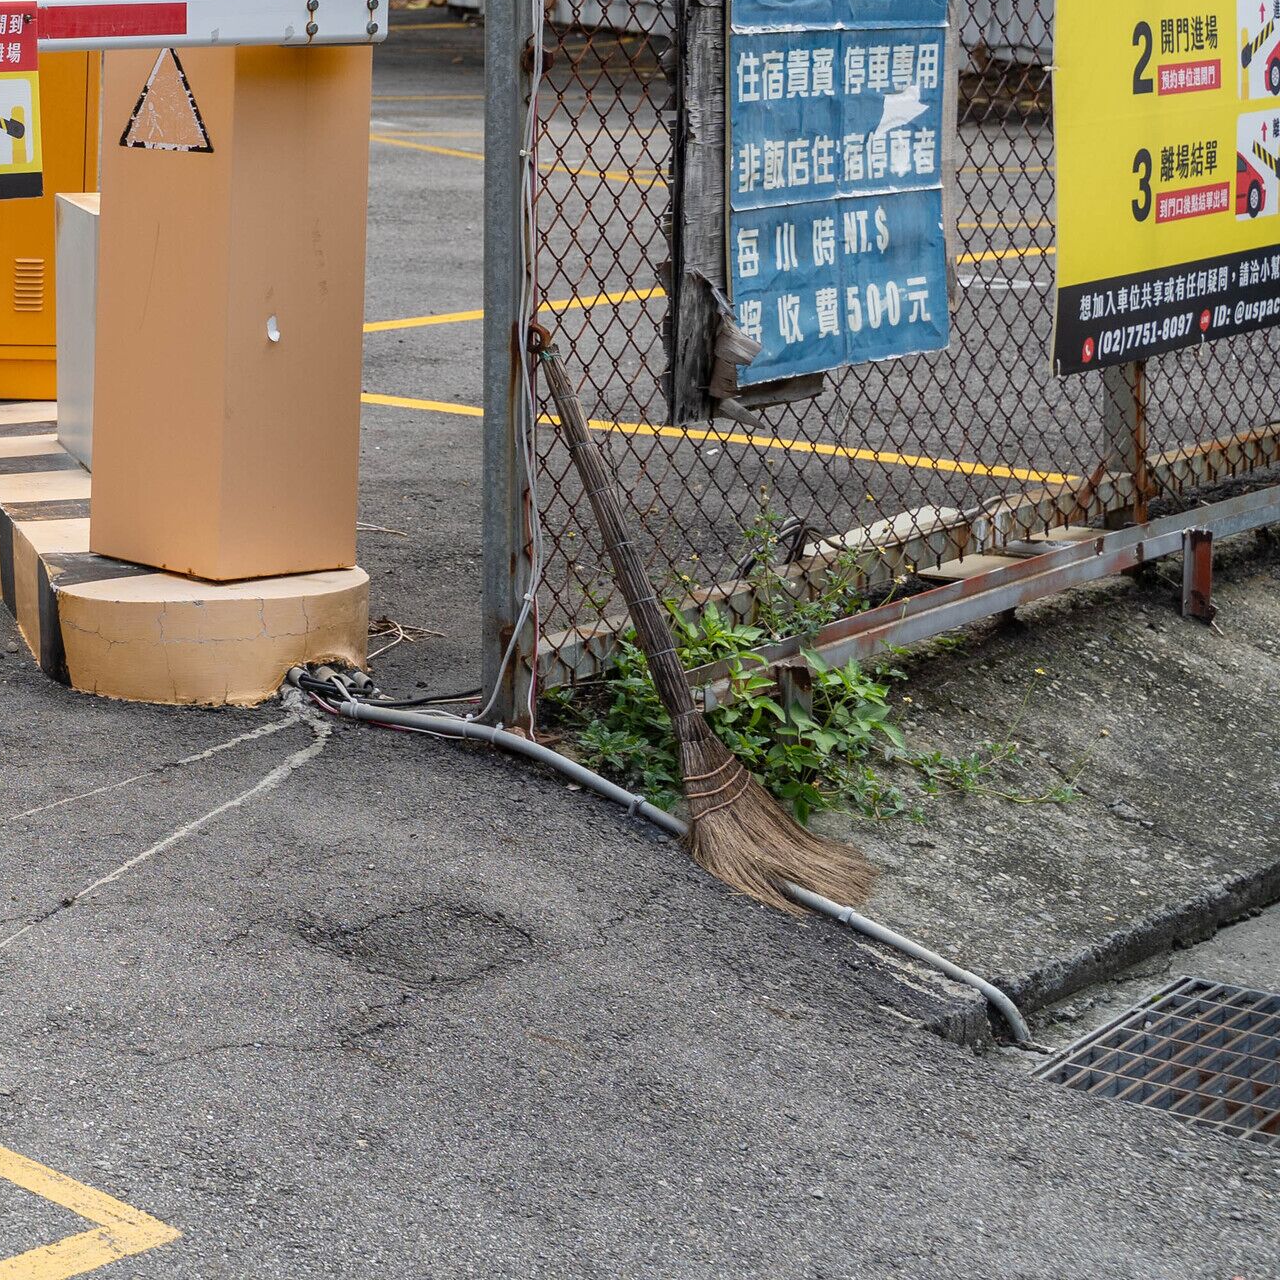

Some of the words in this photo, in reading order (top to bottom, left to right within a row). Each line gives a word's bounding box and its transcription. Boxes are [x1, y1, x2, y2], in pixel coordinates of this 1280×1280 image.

[1132, 20, 1154, 95] 2
[1160, 15, 1218, 55] 開門進場
[1131, 148, 1152, 223] 3
[1160, 140, 1218, 183] 離場結單
[1098, 312, 1194, 360] (02)7751-8097
